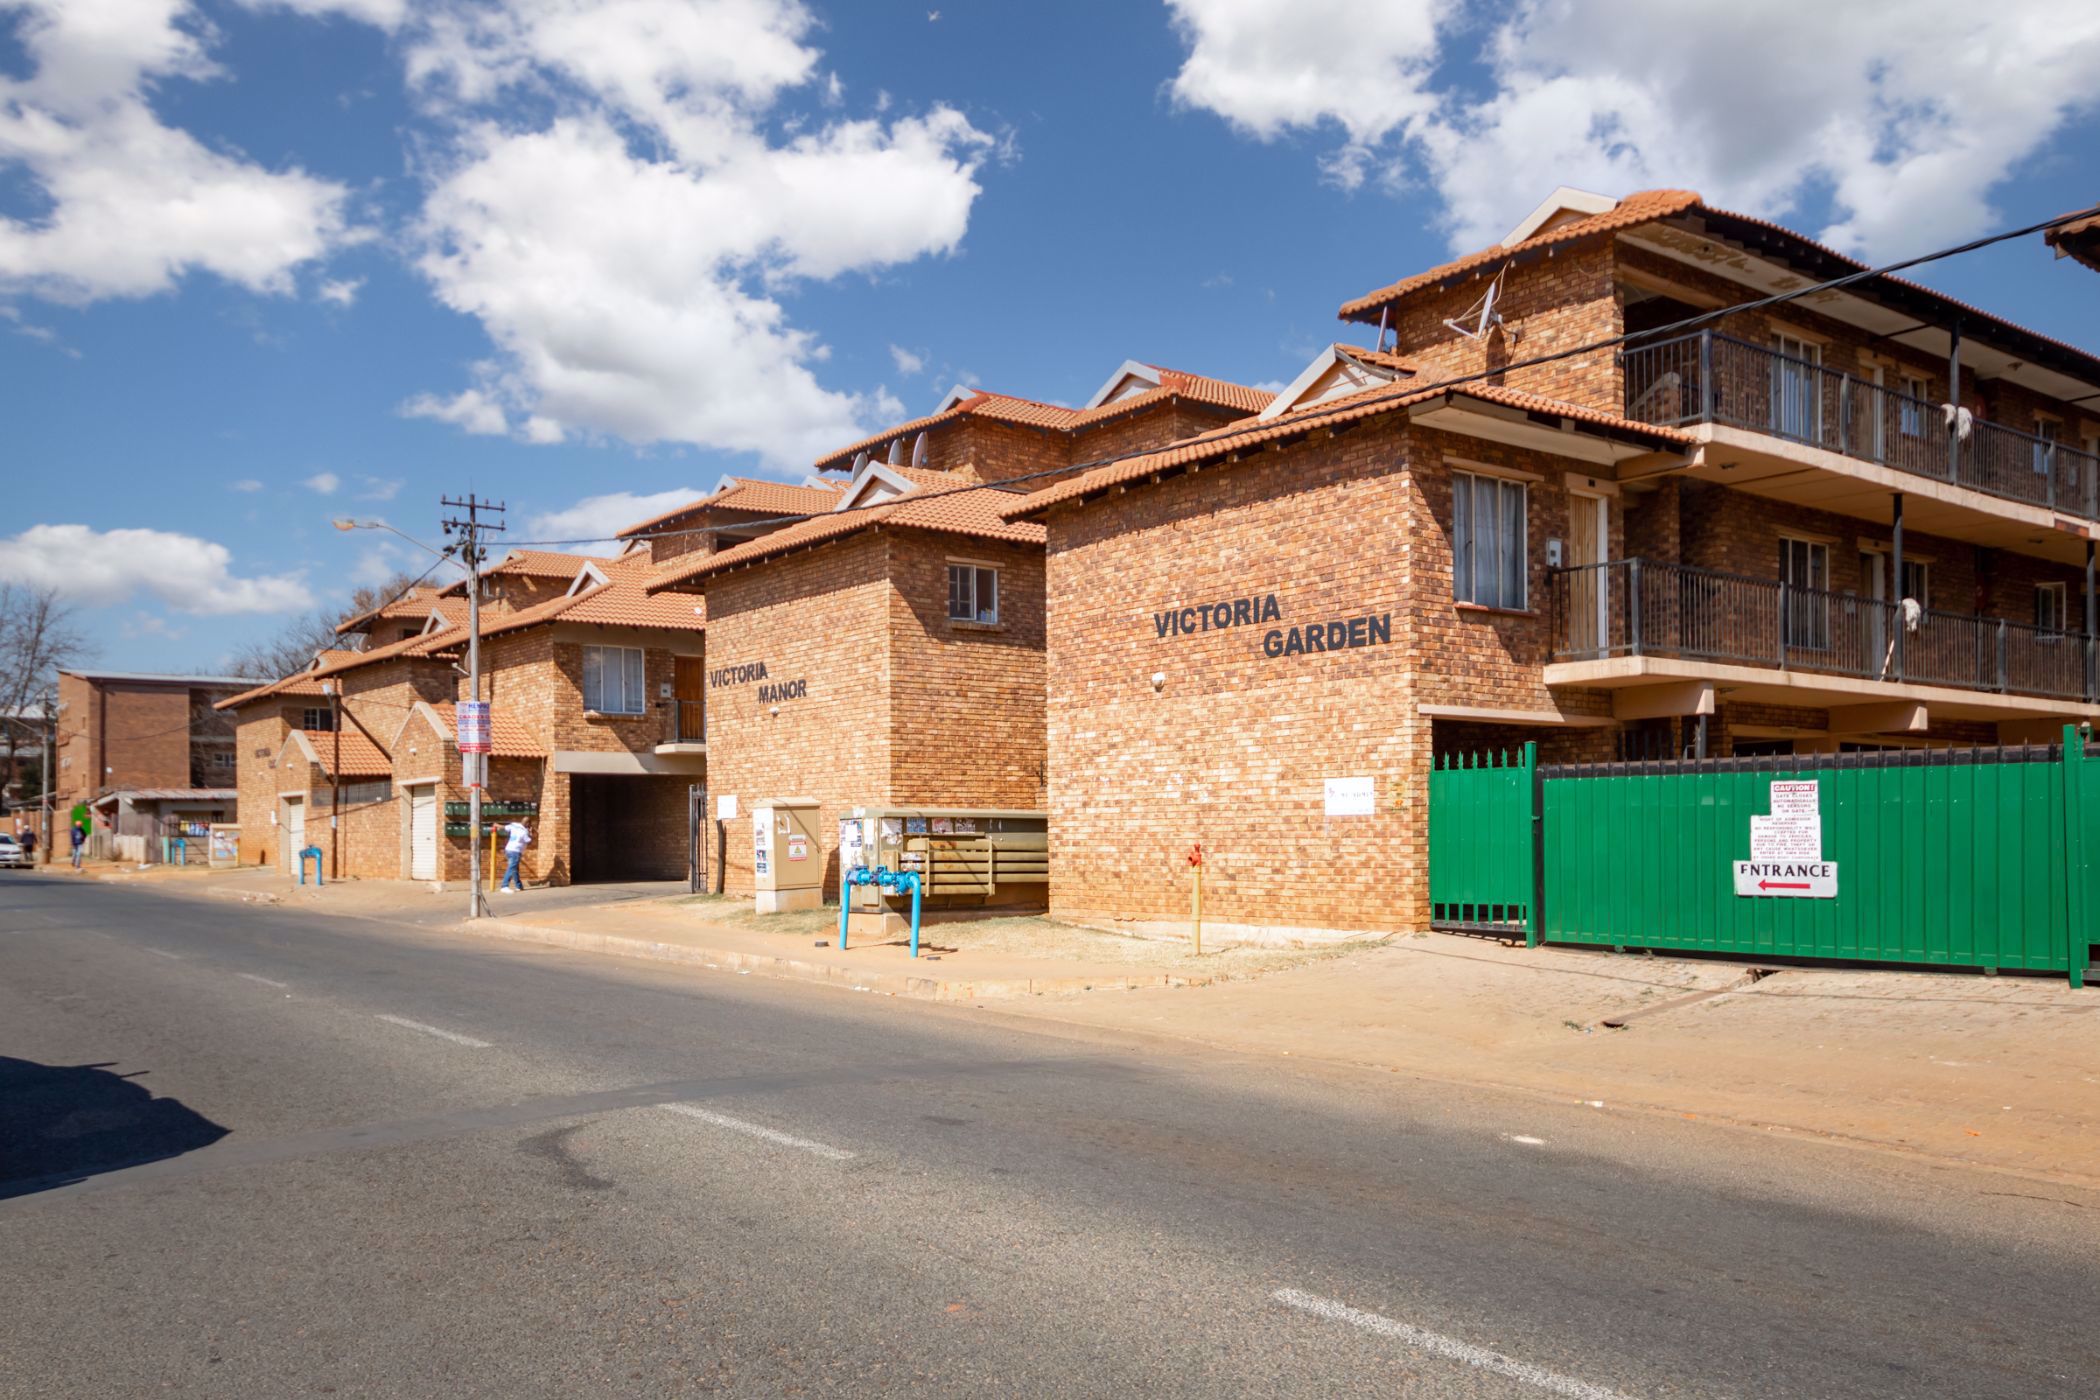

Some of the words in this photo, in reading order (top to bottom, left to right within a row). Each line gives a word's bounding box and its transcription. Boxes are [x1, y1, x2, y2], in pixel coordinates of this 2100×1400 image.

[1154, 594, 1281, 638] VICTORIA
[1263, 613, 1391, 658] GARDEN
[710, 661, 768, 688] VICTORIA
[758, 679, 807, 704] MANOR
[1774, 784, 1815, 792] CAUTION!
